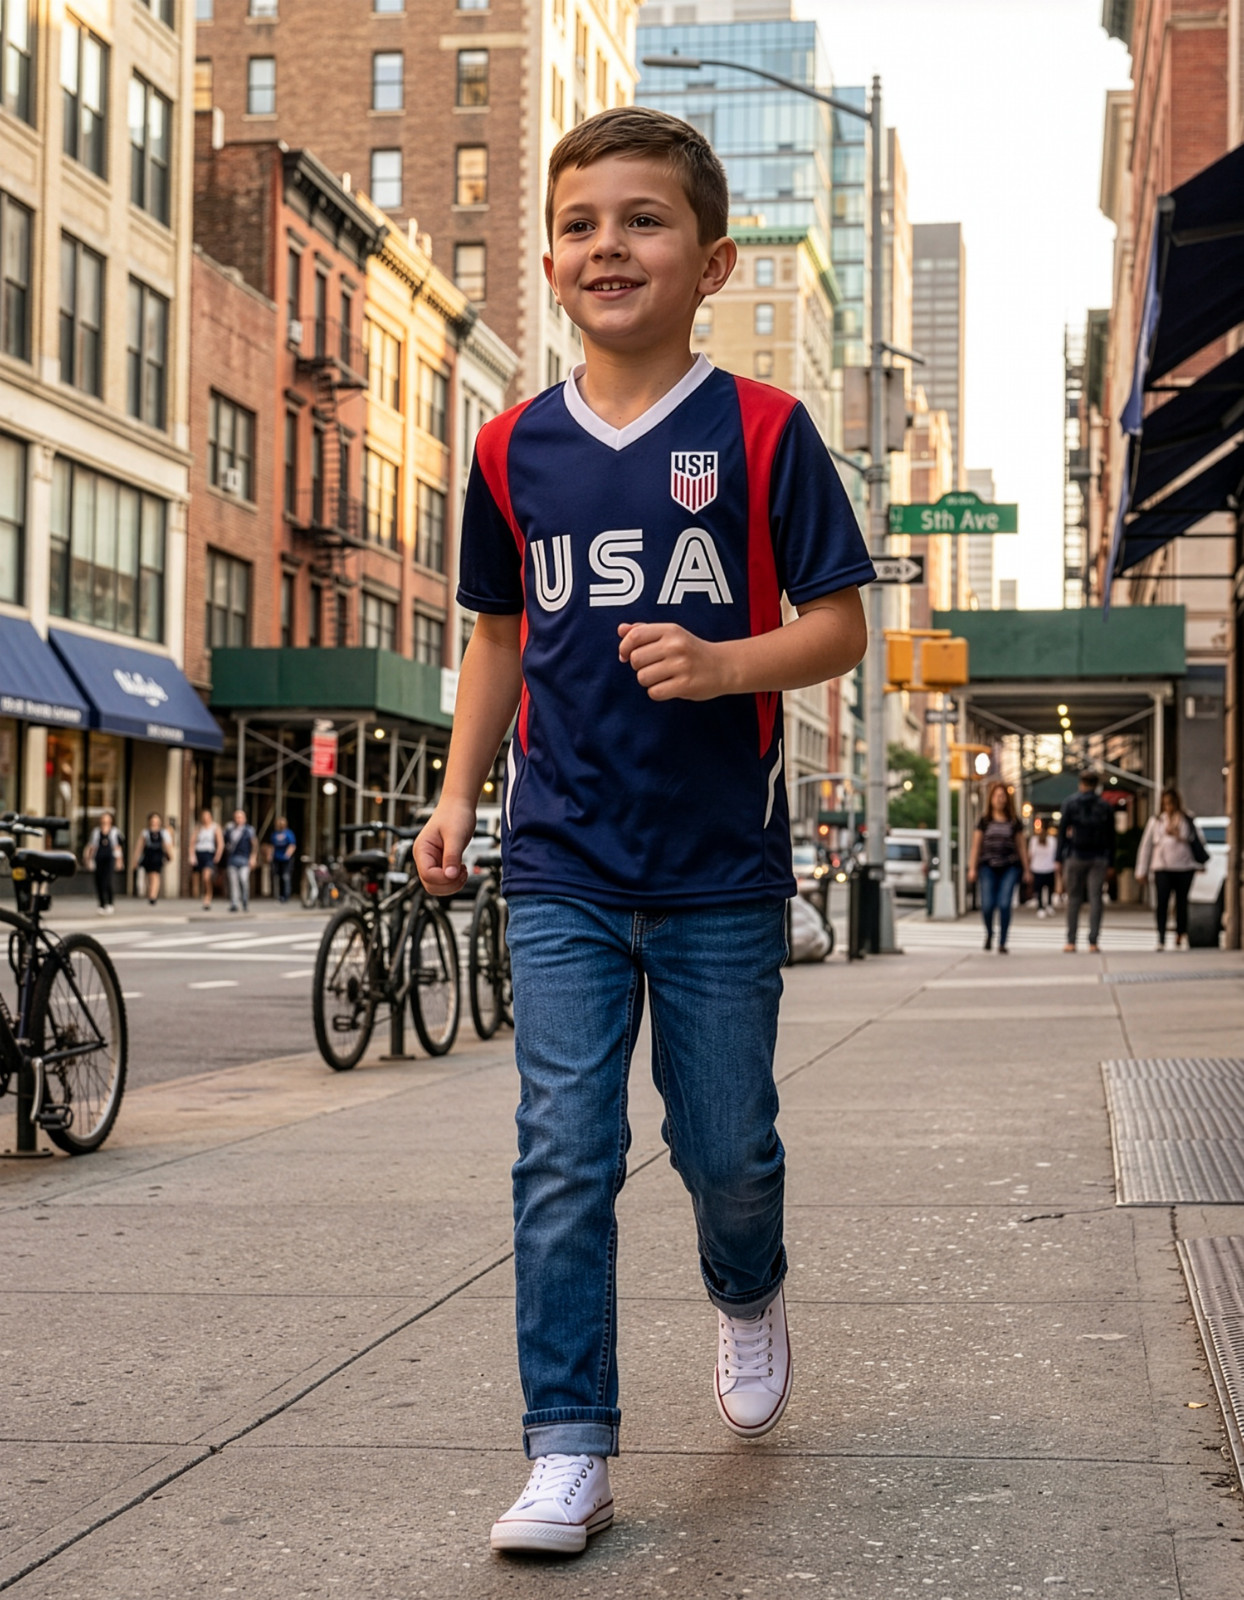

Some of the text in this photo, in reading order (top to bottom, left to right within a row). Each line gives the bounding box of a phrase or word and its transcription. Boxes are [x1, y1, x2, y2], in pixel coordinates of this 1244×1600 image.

[674, 454, 715, 477] USA
[959, 509, 1000, 530] Ave
[530, 527, 734, 612] USA
